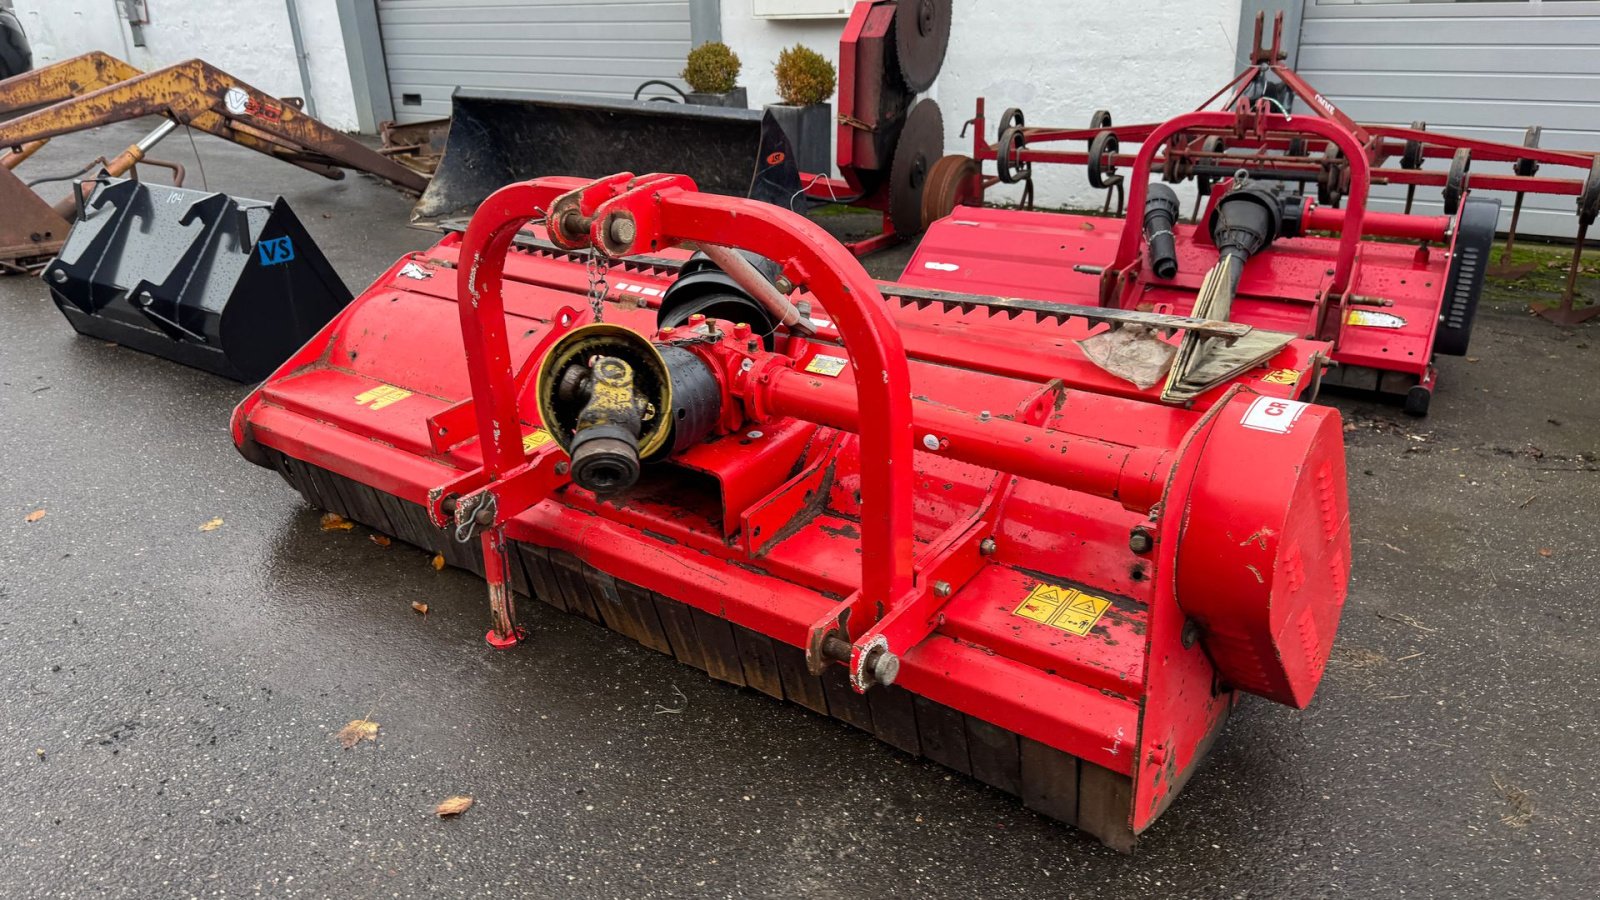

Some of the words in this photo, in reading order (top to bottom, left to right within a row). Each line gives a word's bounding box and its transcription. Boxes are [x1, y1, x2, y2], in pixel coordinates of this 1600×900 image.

[166, 191, 184, 204] 104
[260, 239, 290, 261] VS
[1265, 402, 1289, 416] CR
